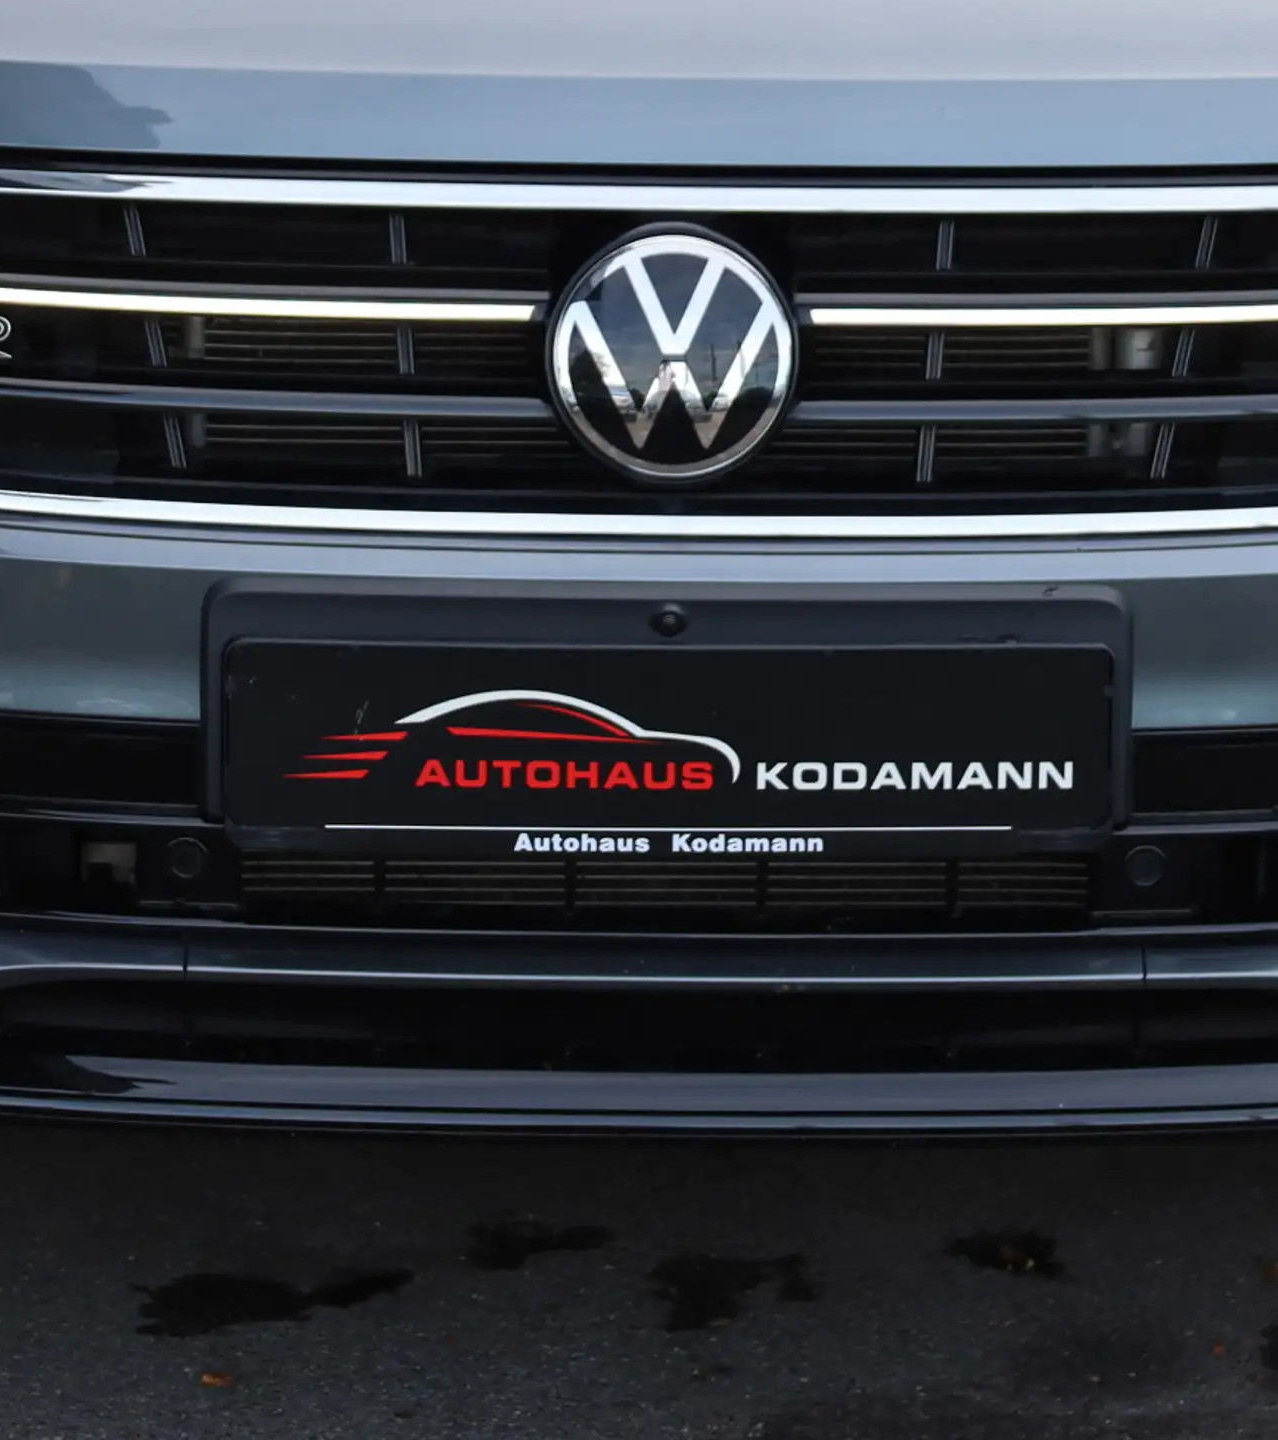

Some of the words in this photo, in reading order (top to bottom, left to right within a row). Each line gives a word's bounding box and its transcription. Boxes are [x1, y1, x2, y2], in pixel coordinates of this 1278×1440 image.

[415, 759, 714, 790] AUTOHAUS
[756, 761, 1074, 791] KODAMANN
[513, 830, 651, 854] Autohaus
[671, 830, 824, 854] Kodamann
